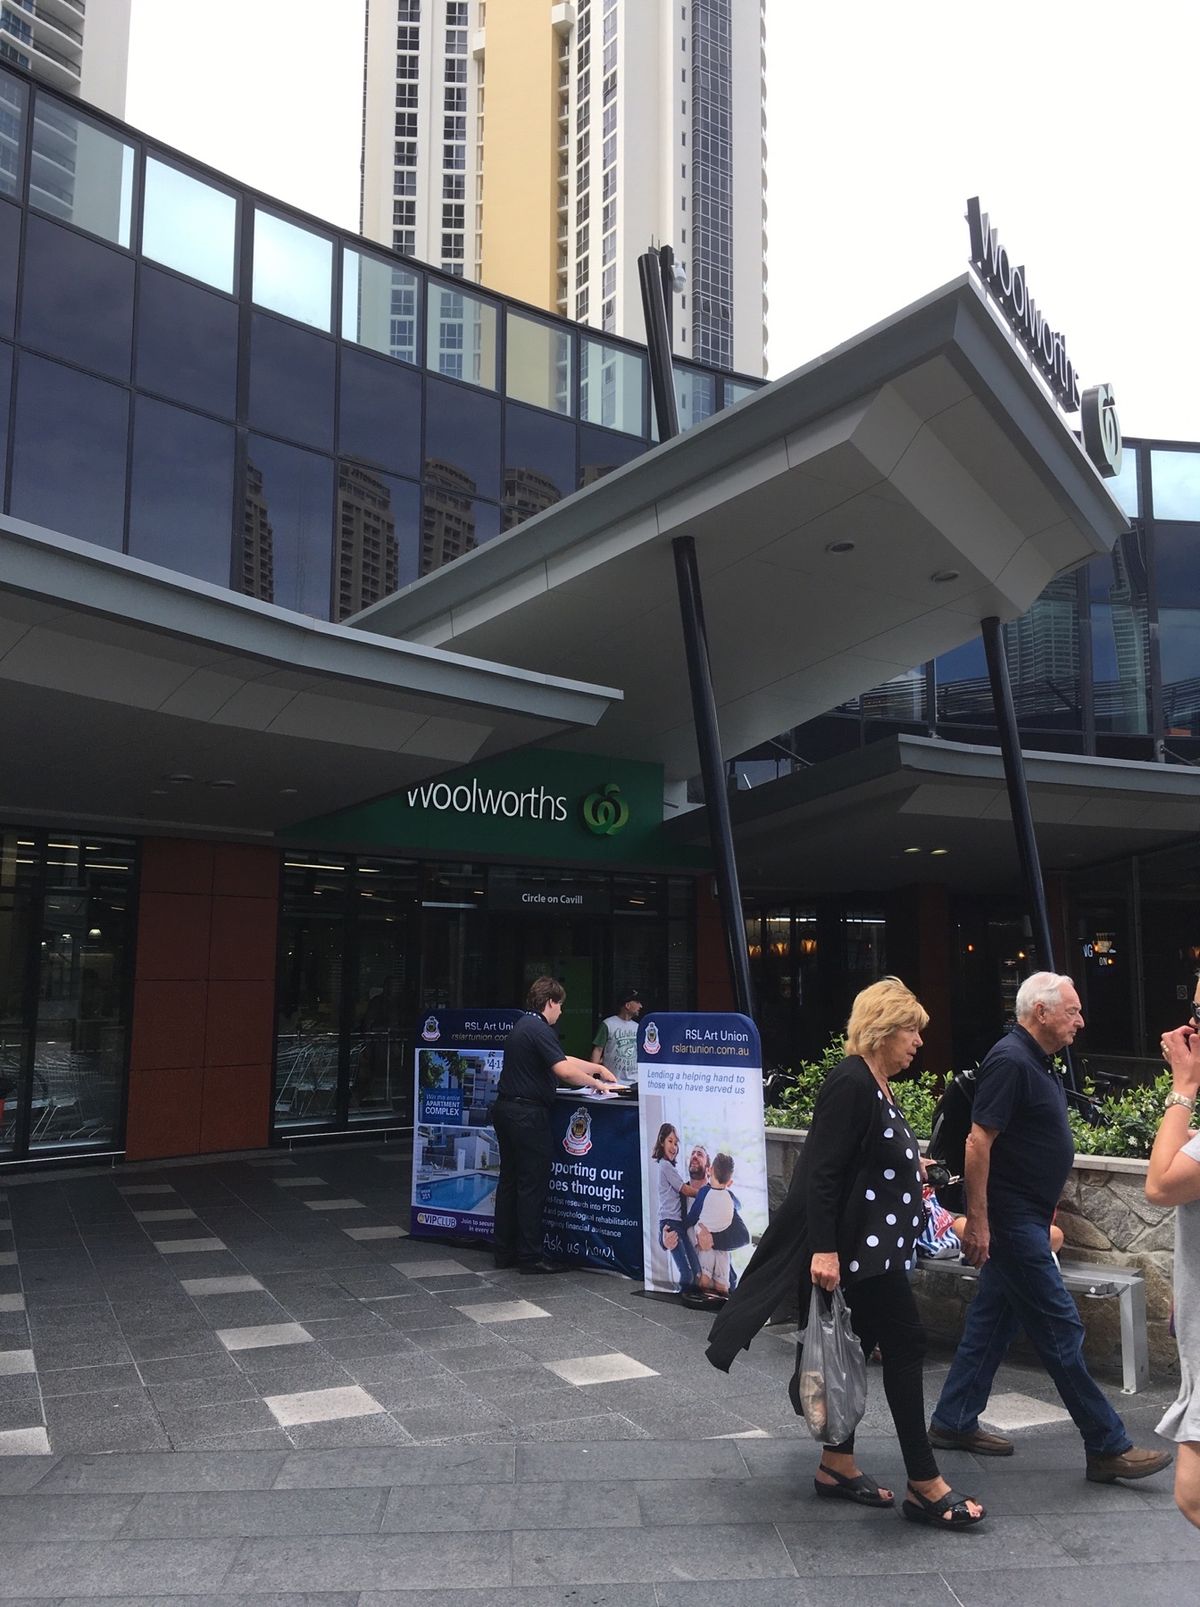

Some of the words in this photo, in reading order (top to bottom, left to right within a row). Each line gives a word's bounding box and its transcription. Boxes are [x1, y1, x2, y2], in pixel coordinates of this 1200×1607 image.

[964, 196, 1080, 413] Woolworths
[407, 777, 568, 822] Woolworths
[521, 893, 546, 903] Circle
[547, 895, 558, 903] on
[560, 894, 583, 904] Cavill
[464, 1021, 481, 1031] RSL
[483, 1022, 496, 1031] Art
[498, 1021, 514, 1031] Uni
[685, 1029, 702, 1040] RSL
[703, 1030, 718, 1041] Art
[720, 1030, 749, 1042] Union
[671, 1043, 750, 1056] rslartunion.com.au
[647, 1069, 674, 1080] Lending
[682, 1071, 711, 1083] helping
[713, 1073, 734, 1083] hand
[736, 1075, 745, 1084] to
[647, 1080, 666, 1090] those
[667, 1081, 682, 1091] who
[684, 1082, 703, 1092] have
[705, 1083, 732, 1094] served
[734, 1086, 745, 1095] us
[425, 1100, 460, 1108] APARTMENT
[425, 1107, 460, 1116] COMPLEX
[551, 1162, 597, 1181] porting
[600, 1168, 624, 1181] our
[548, 1180, 569, 1192] oes
[571, 1180, 625, 1201] through:
[590, 1201, 601, 1210] into
[602, 1204, 622, 1214] PTSD
[595, 1216, 638, 1227] rehabilitation
[543, 1233, 564, 1253] Ask
[567, 1242, 580, 1255] us
